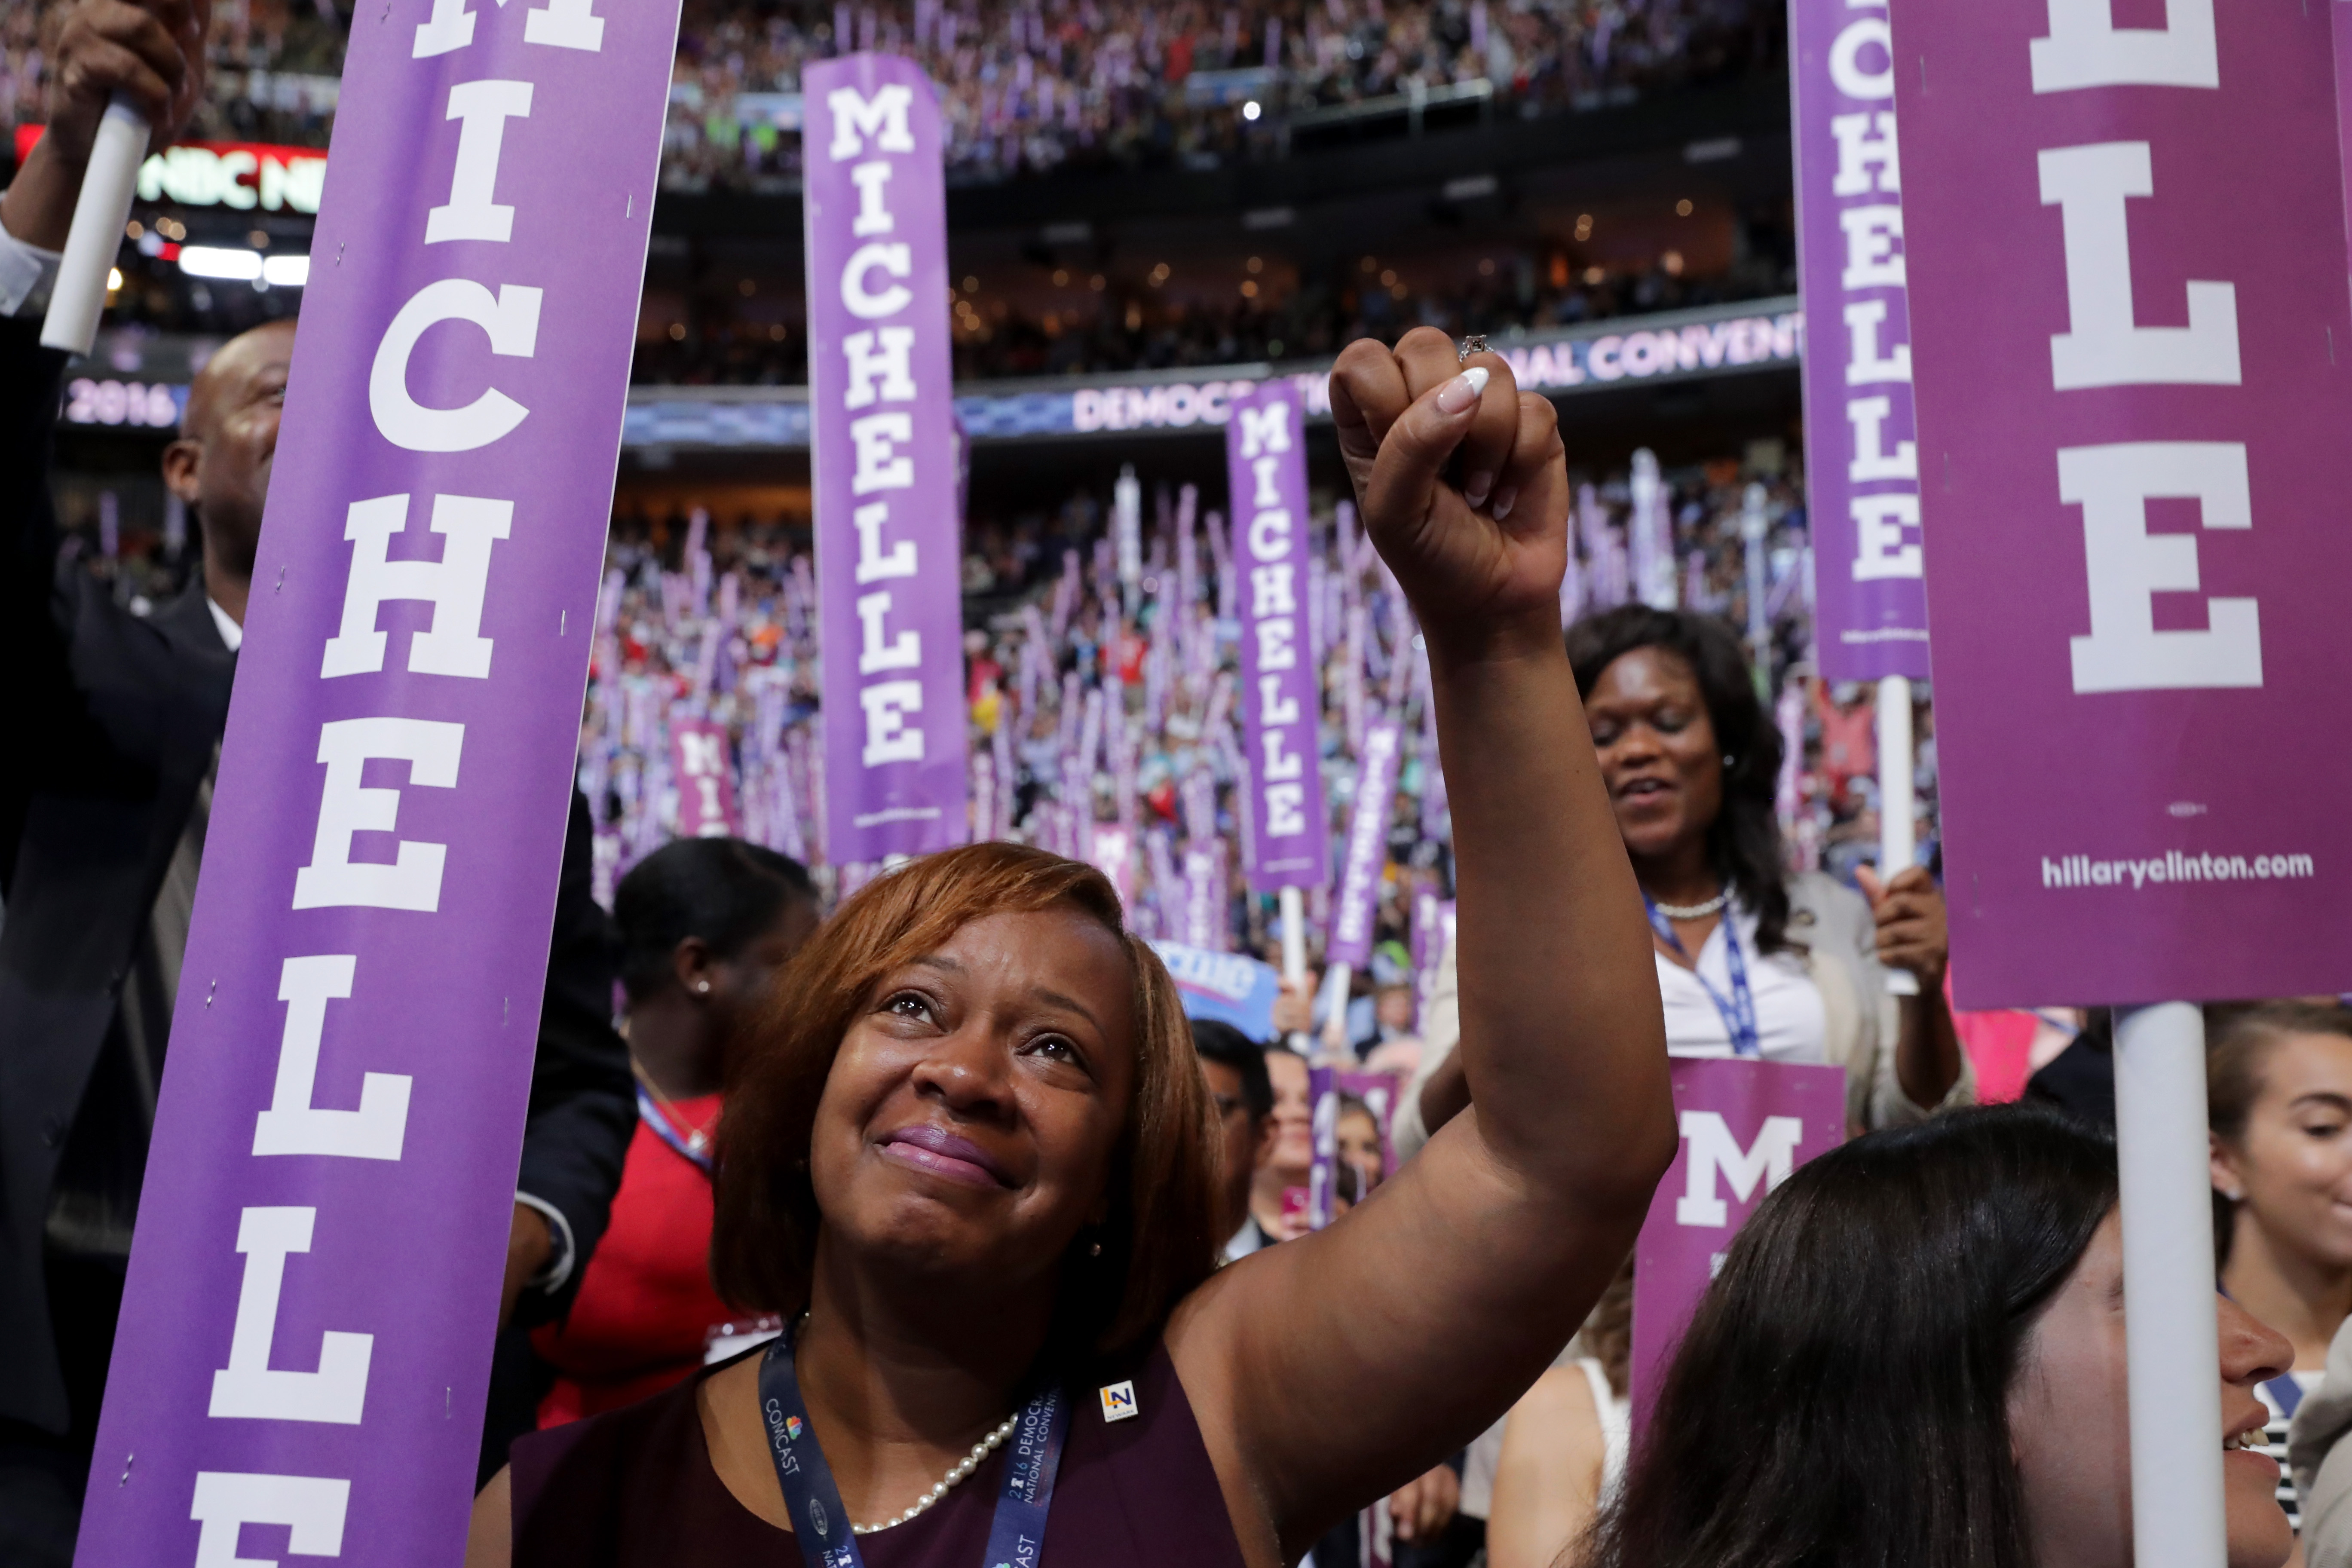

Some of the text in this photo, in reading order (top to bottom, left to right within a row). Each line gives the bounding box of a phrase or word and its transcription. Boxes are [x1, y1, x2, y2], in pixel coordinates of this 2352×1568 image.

[1828, 0, 1924, 582] CHELLE
[67, 377, 177, 428] 2016
[828, 83, 925, 768] MICHELLE
[1238, 400, 1305, 838] MICHELLE
[190, 0, 605, 1568] ICHELL
[2041, 849, 2314, 890] hillaryclinton.com
[766, 1398, 800, 1476] COMCAST
[1024, 1449, 1045, 1504] NATIONAL
[1014, 1534, 1035, 1568] AST
